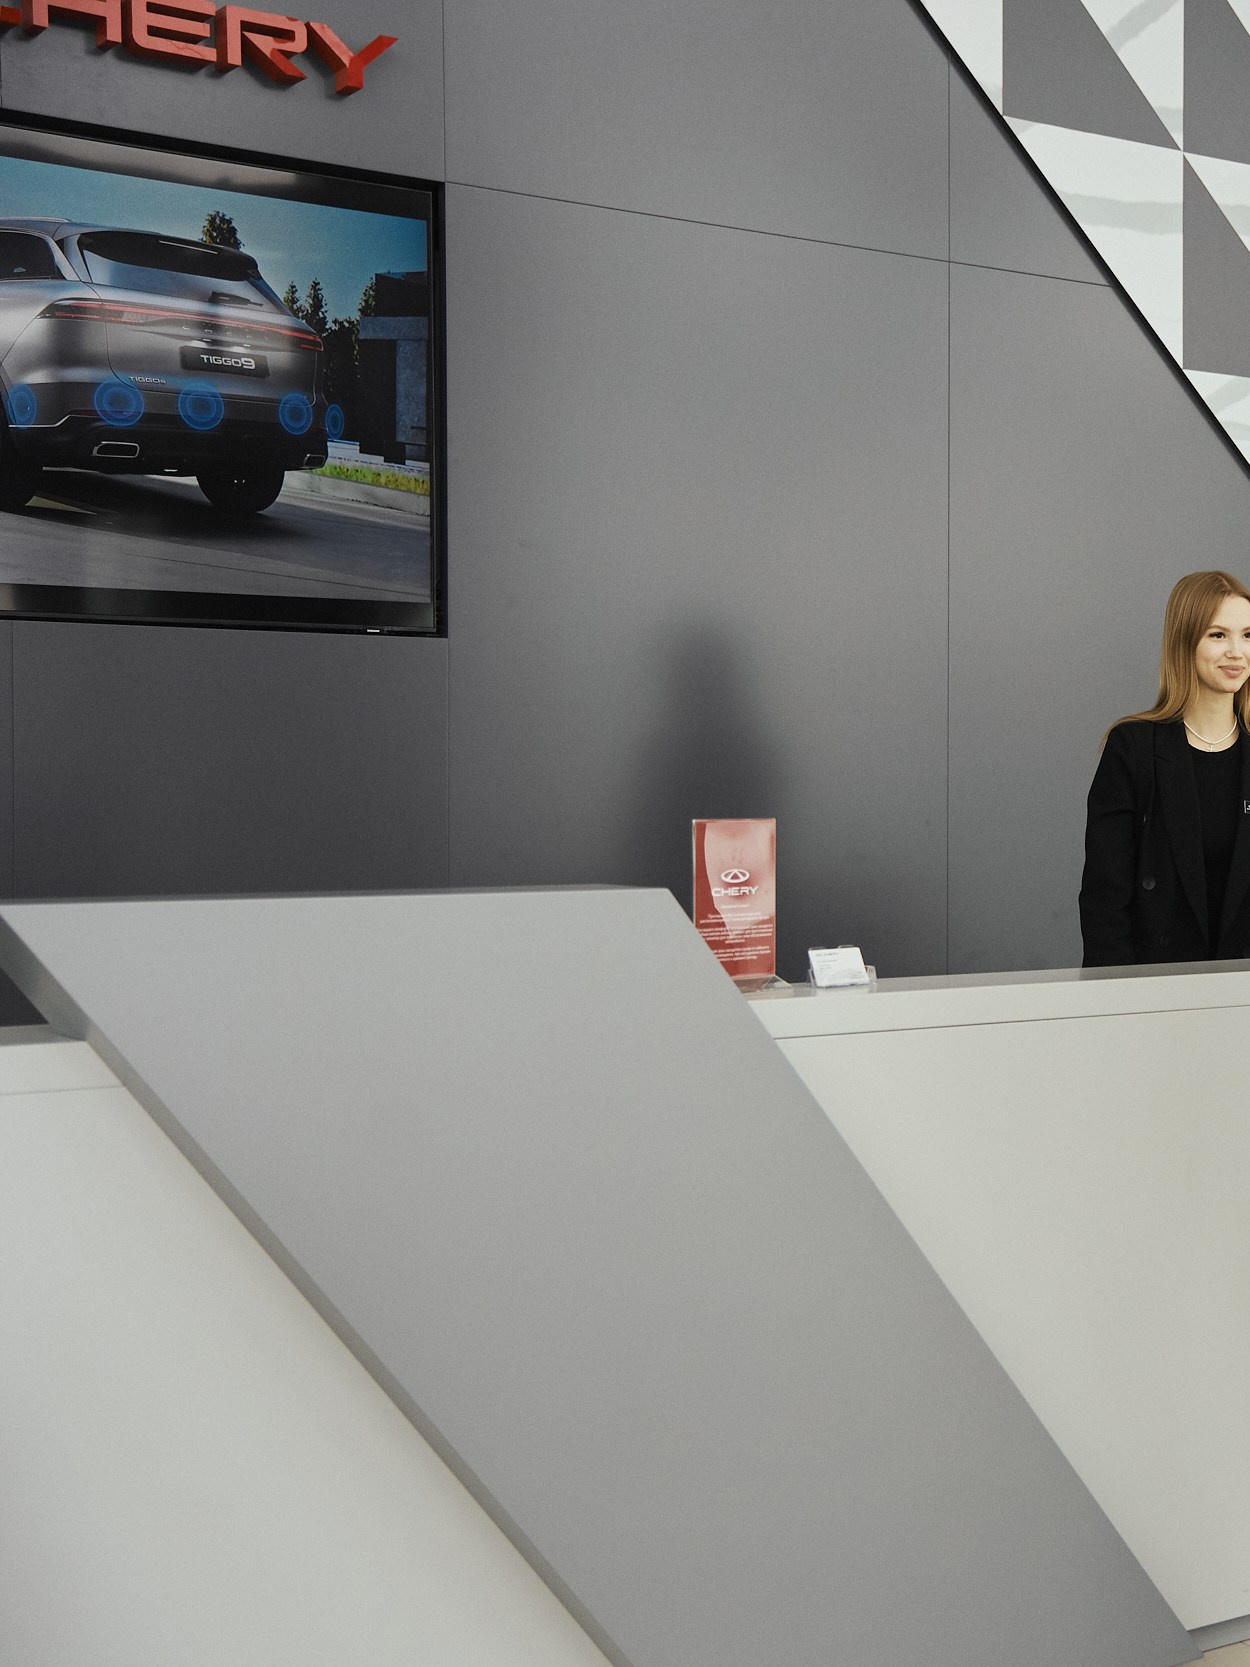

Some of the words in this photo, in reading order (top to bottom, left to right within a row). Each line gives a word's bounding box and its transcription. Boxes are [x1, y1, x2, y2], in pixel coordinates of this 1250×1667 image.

[0, 0, 399, 95] HERY
[200, 354, 256, 370] TIGGO9
[711, 886, 759, 897] CHERY
